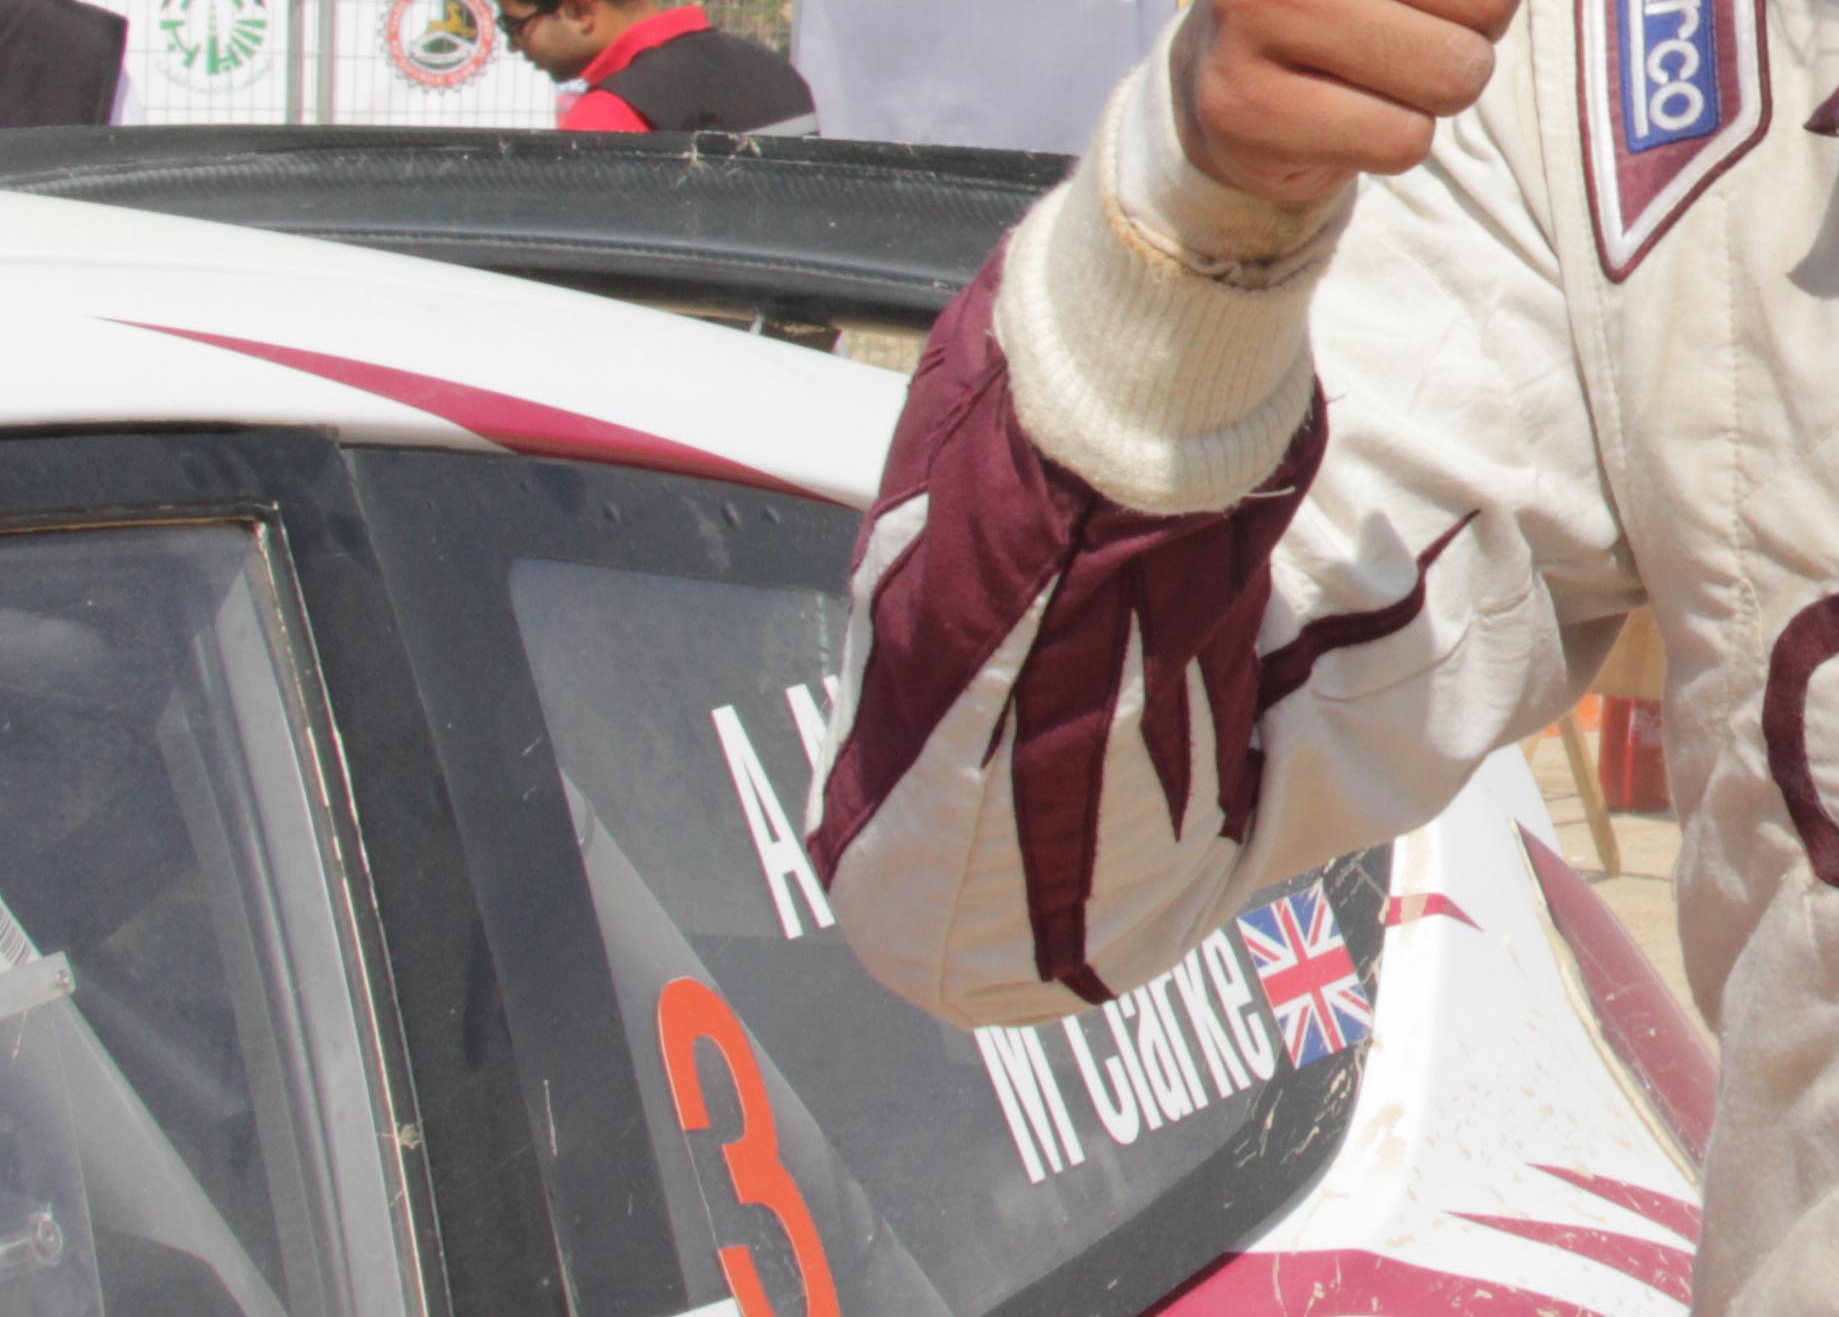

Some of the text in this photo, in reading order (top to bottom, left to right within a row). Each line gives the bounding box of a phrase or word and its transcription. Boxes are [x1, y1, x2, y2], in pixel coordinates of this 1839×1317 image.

[711, 704, 836, 940] A
[658, 976, 841, 1317] 3
[1062, 928, 1276, 1146] Clarke
